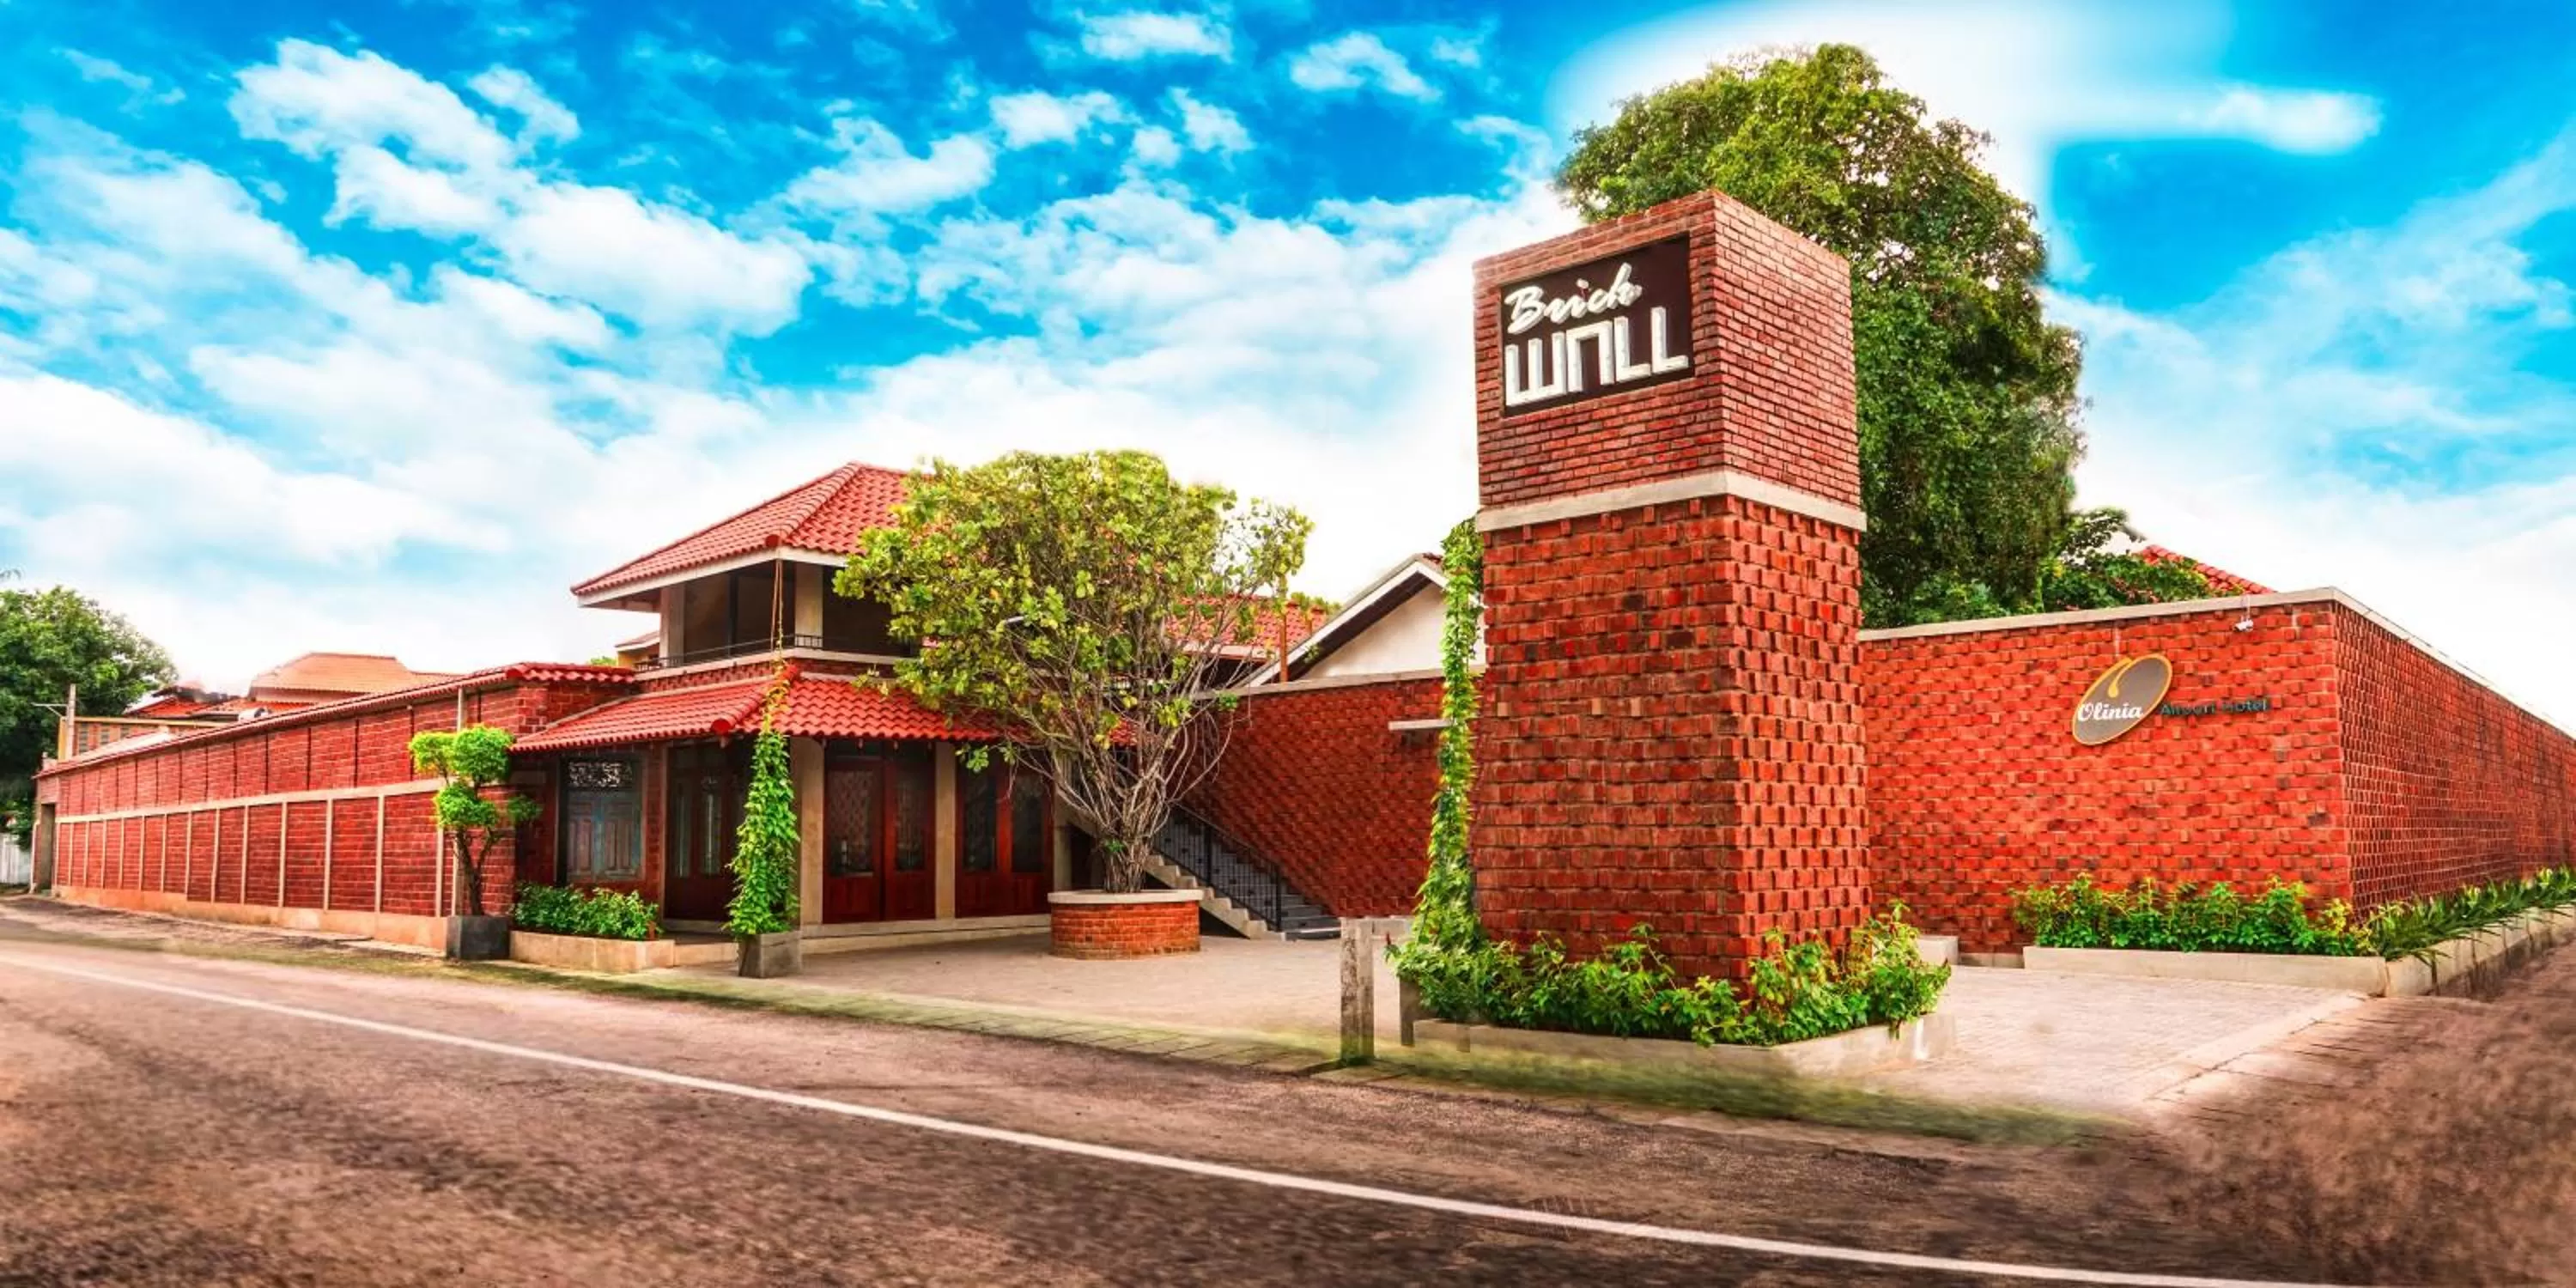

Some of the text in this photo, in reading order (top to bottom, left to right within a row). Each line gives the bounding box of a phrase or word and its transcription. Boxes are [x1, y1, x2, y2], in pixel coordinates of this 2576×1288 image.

[1504, 262, 1643, 334] Brick
[1504, 307, 1689, 407] WALL
[2076, 702, 2144, 722] Olinia
[2222, 699, 2268, 714] Hotel
